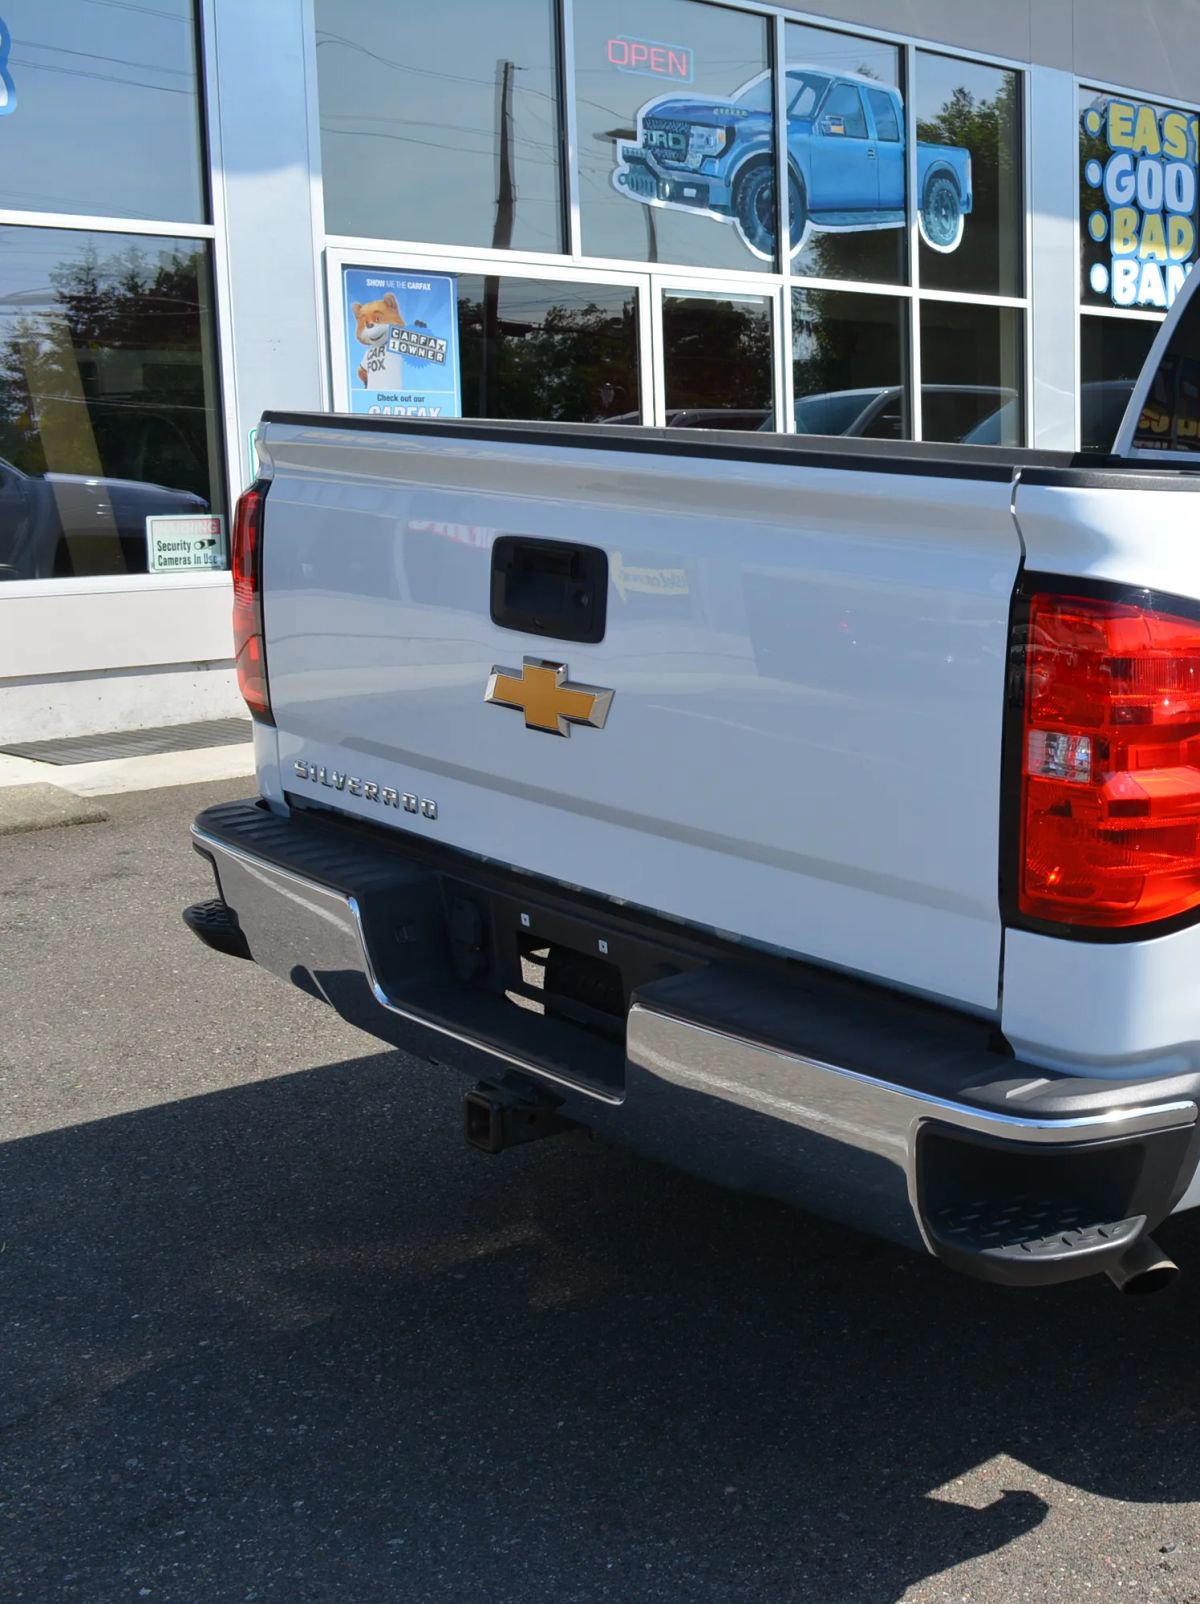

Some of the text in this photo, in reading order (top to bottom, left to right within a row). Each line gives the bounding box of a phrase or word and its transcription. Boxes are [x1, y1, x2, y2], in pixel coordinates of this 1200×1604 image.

[607, 39, 688, 77] OPEN
[1112, 207, 1194, 262] BAD
[366, 278, 385, 288] SHOW
[407, 281, 432, 291] CARFAX
[391, 328, 445, 351] CARFAX
[367, 346, 386, 360] CAR
[367, 358, 386, 372] FOX
[377, 393, 399, 402] Check
[400, 394, 412, 402] out
[157, 539, 191, 553] Security
[158, 552, 218, 566] Cameras In Use
[294, 758, 438, 821] SILVERADO
